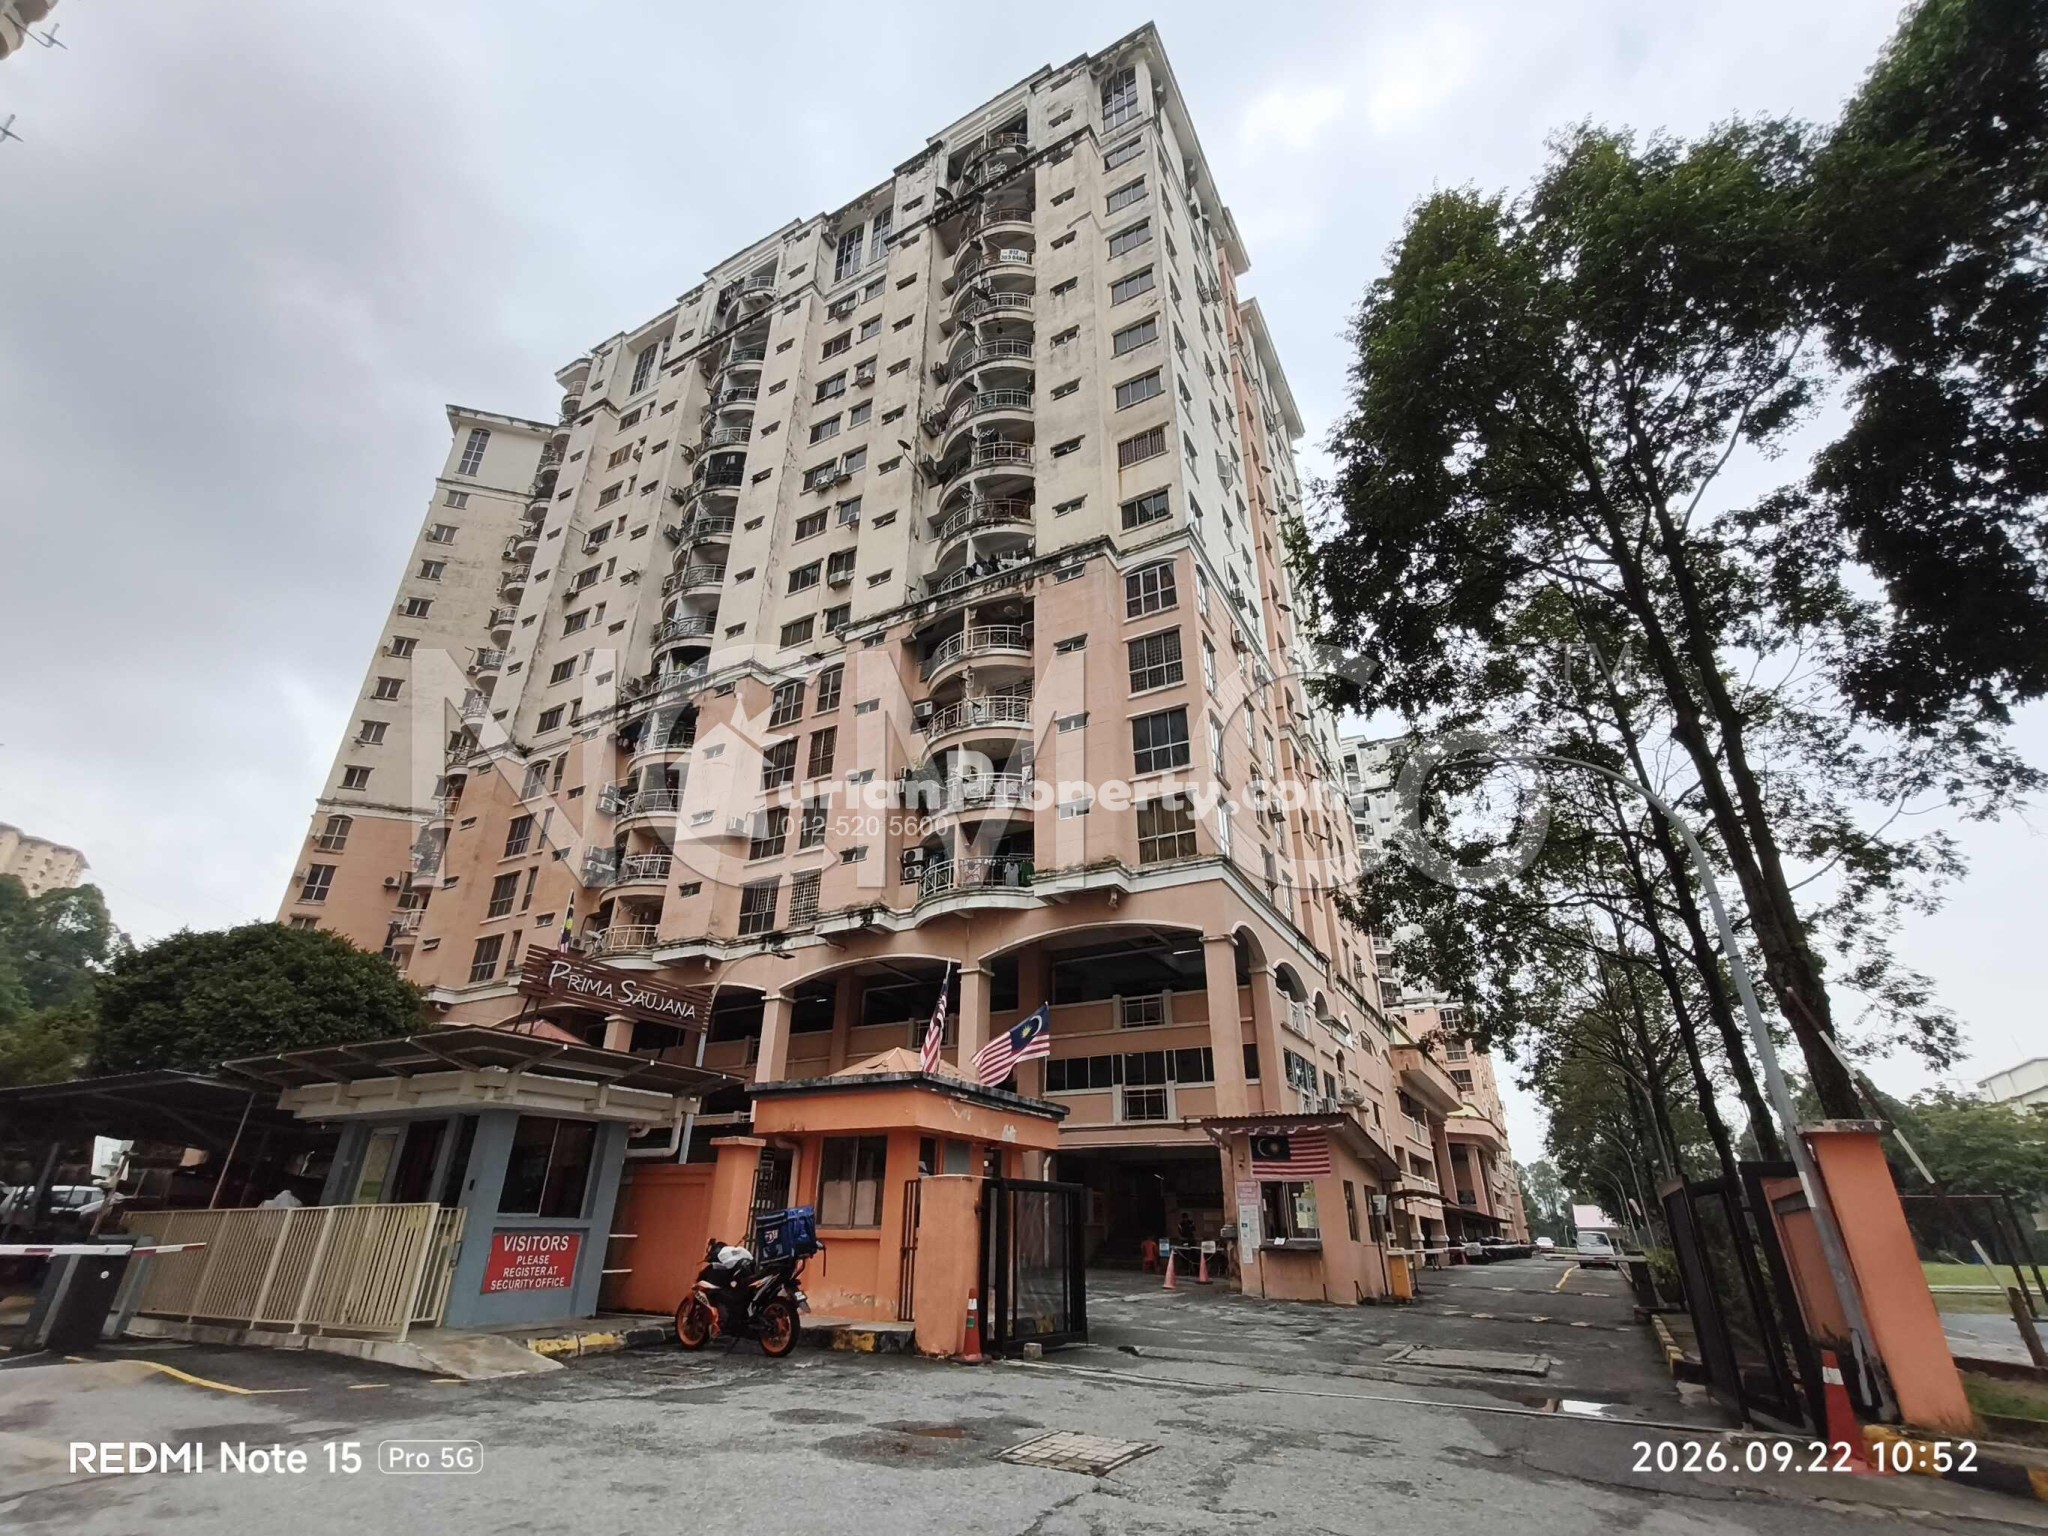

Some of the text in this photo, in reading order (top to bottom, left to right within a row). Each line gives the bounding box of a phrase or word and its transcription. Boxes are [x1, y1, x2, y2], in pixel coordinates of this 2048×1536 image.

[548, 960, 696, 1020] PRIMA SAUJANA
[503, 1235, 569, 1252] VISITORS
[516, 1254, 550, 1265] PLEASE
[502, 1265, 558, 1277] REGISTER AT
[490, 1277, 565, 1290] SECURITY OFFICE
